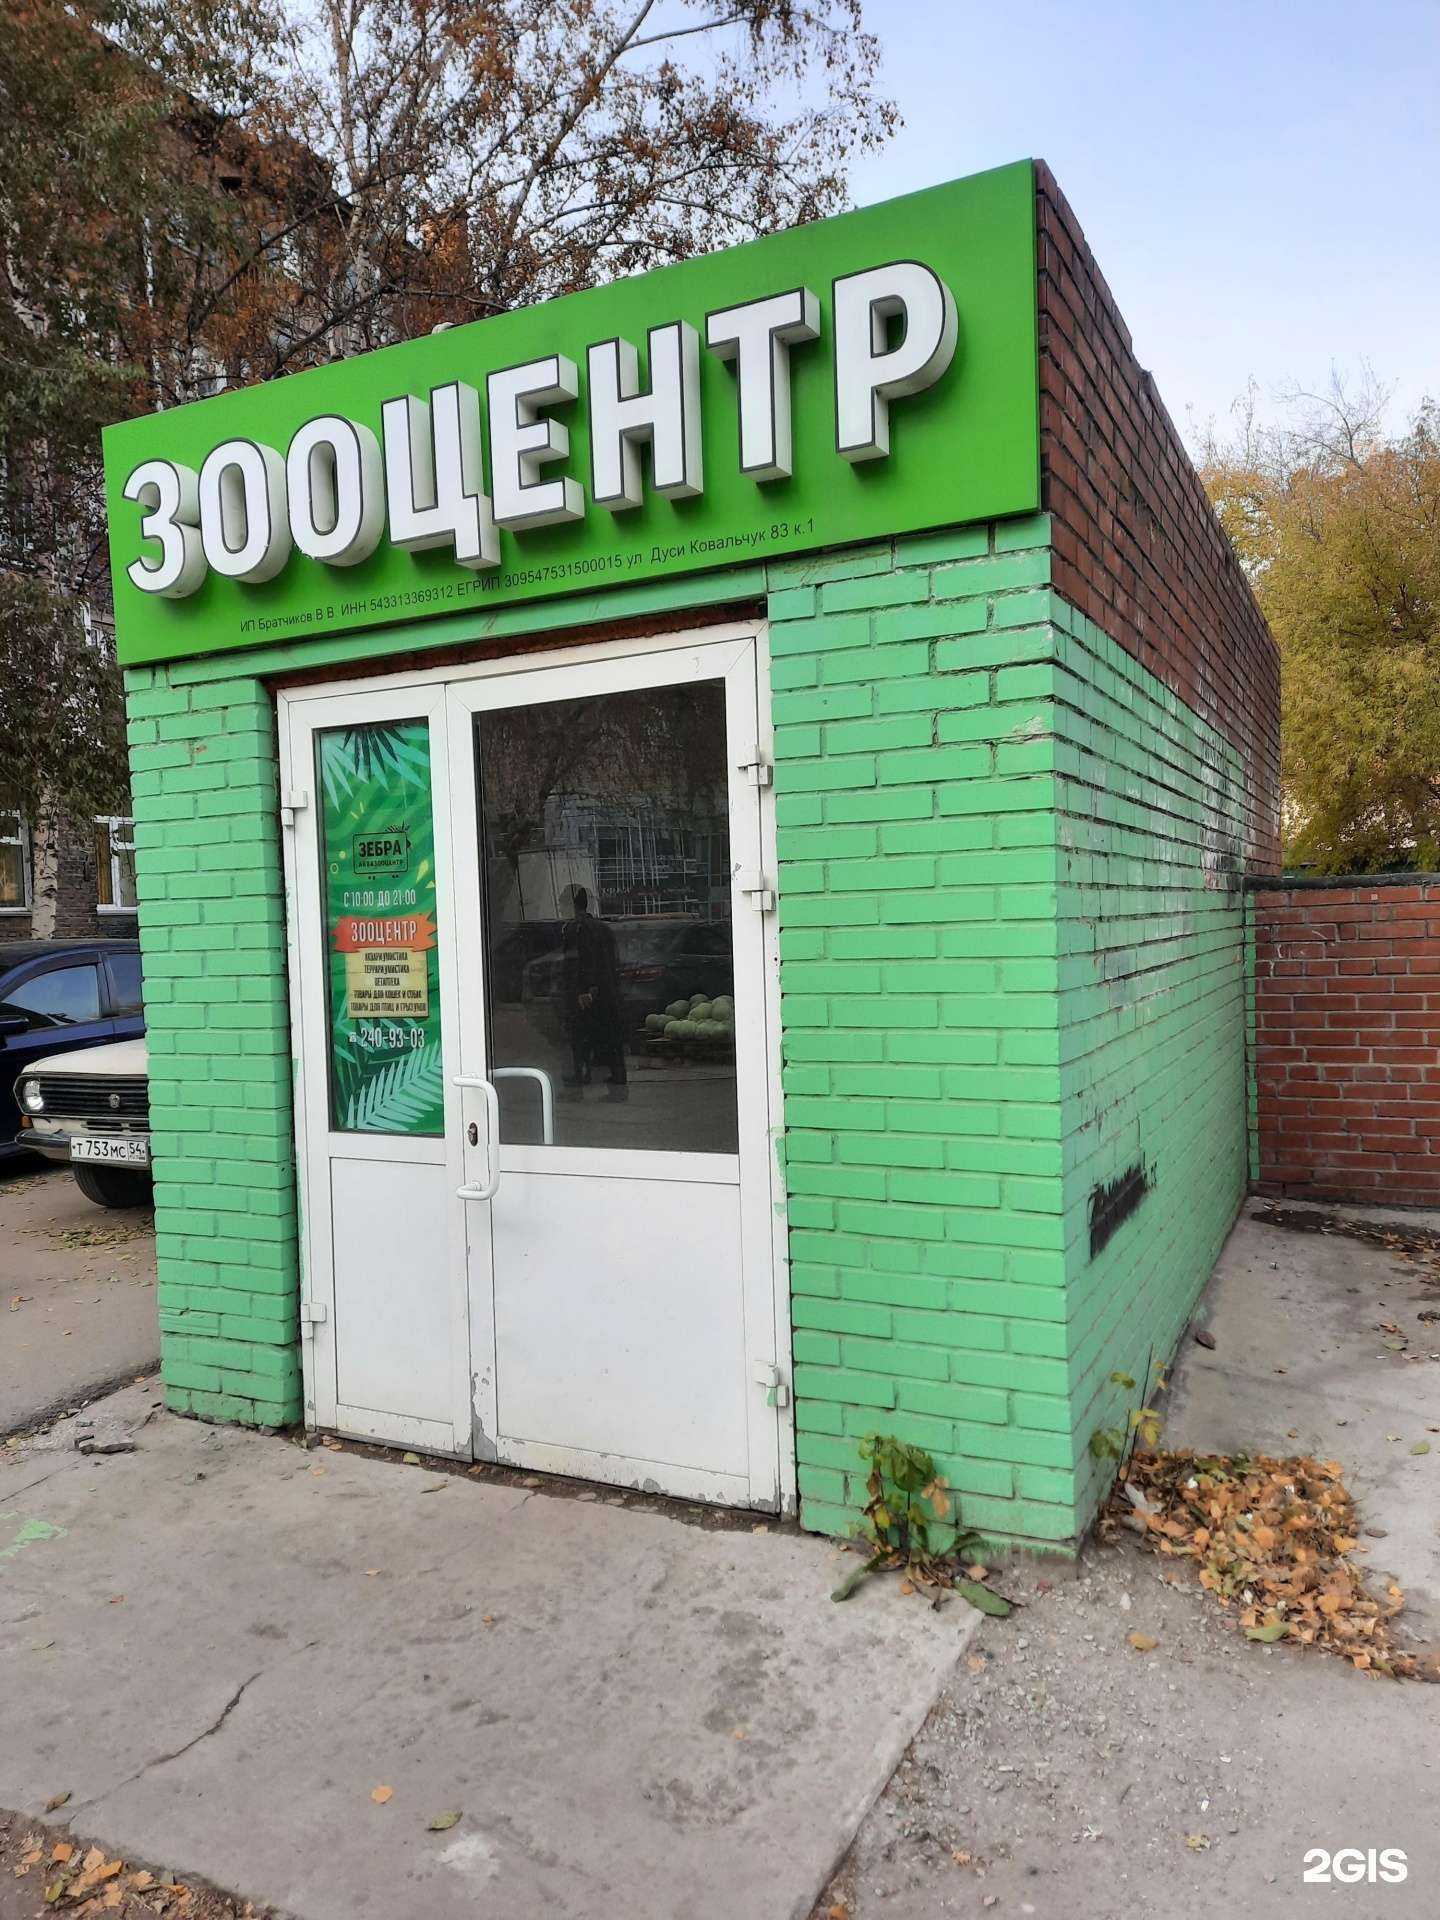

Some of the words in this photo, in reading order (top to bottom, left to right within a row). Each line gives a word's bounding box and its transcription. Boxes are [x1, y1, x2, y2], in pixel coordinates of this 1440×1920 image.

[123, 259, 958, 598] ЗООЦЕНТР
[240, 619, 255, 632] ИП
[258, 612, 313, 632] Братчиков
[316, 608, 323, 620] В
[327, 606, 335, 618] В
[341, 601, 367, 617] ИНН
[370, 586, 453, 612] 543313369312
[457, 576, 500, 597] ЕГРИП
[504, 553, 622, 588] 309547531500015
[626, 552, 642, 569] ул
[650, 544, 685, 564] Дуси
[690, 529, 766, 555] Ковальчук
[770, 522, 789, 540] 83
[358, 840, 402, 858] ЗЕБРА
[377, 890, 391, 908] ДО
[351, 921, 417, 945] ЗООЦЕНТР
[360, 1027, 425, 1049] 240-93-03
